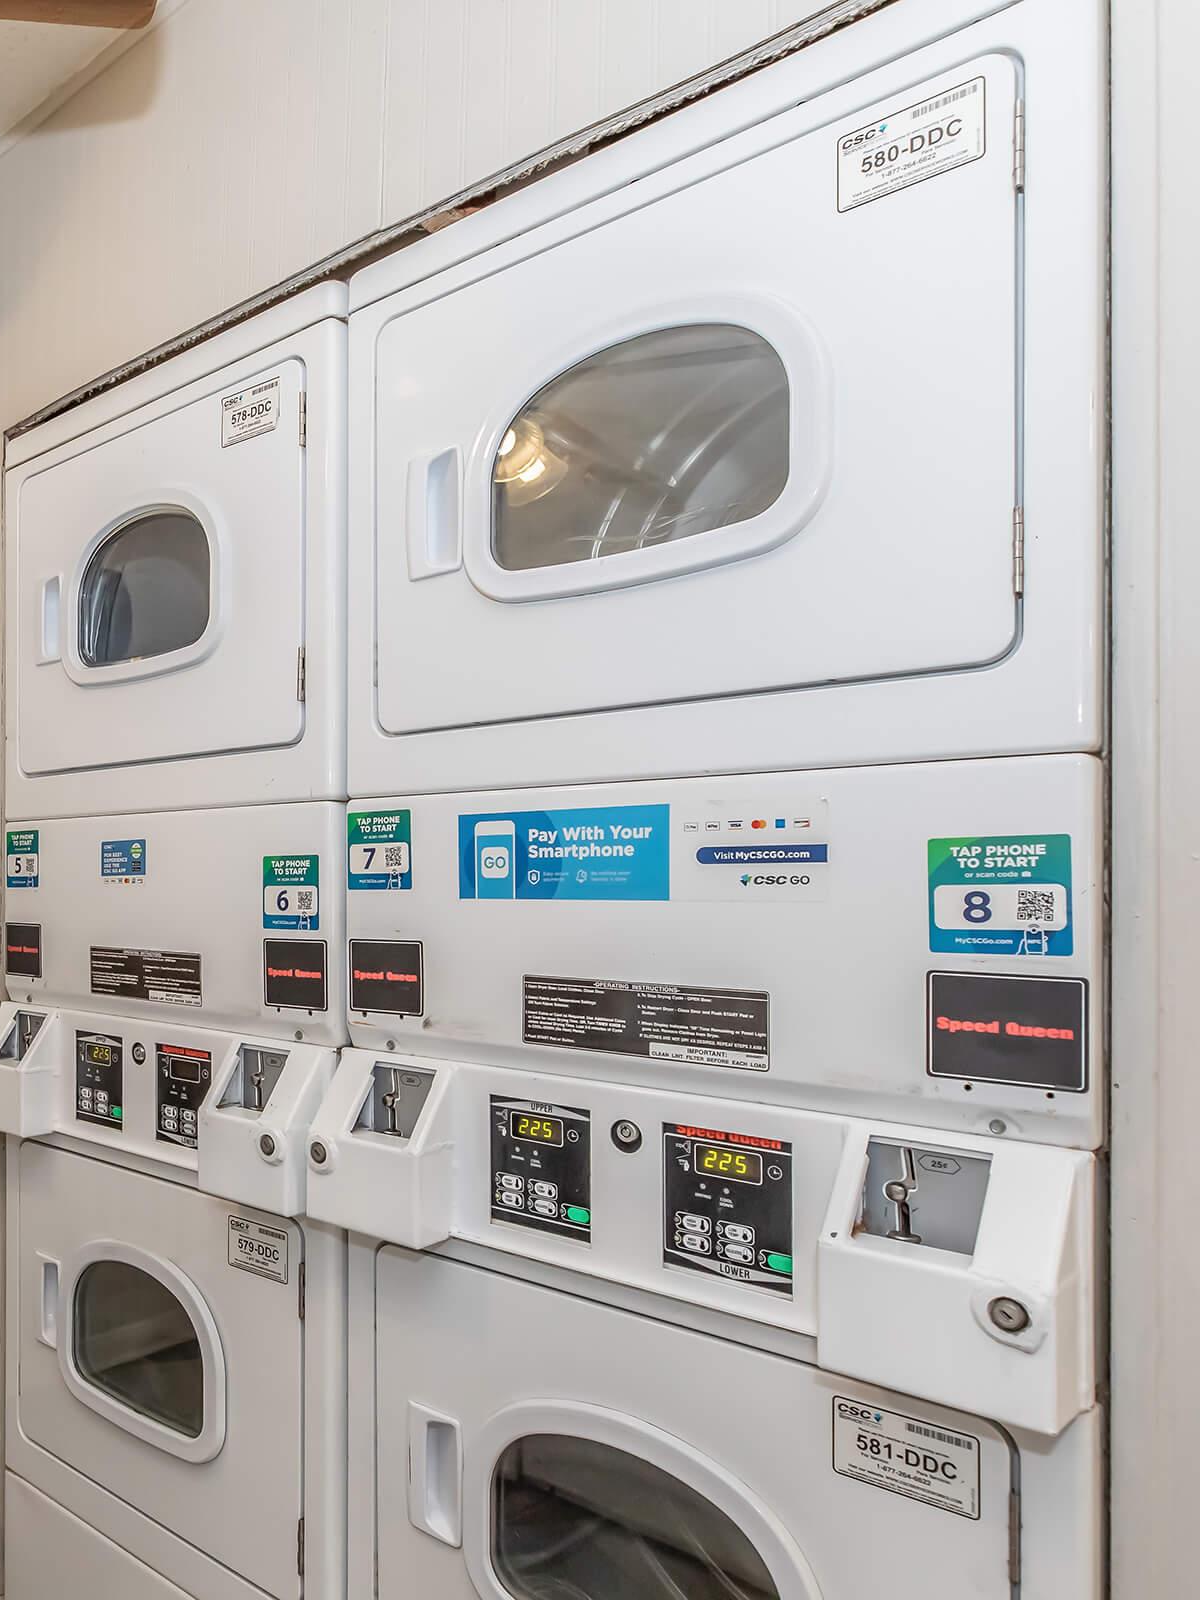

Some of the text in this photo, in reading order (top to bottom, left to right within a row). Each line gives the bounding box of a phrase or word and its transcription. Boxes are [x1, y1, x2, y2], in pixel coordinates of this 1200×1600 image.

[842, 129, 876, 150] CSC
[861, 118, 963, 173] 580-DDC
[224, 397, 238, 407] CSC
[231, 400, 272, 425] 578-DDC
[356, 816, 400, 826] TAP PHONE
[372, 824, 397, 832] START
[528, 825, 652, 844] Pay With Your
[528, 844, 634, 860] Smartphone
[714, 850, 810, 861] Visit MyCSCGO.com
[950, 844, 1047, 857] TAP PHONE
[15, 858, 22, 874] 5
[272, 860, 310, 868] TAP PHONE
[363, 848, 376, 870] 7
[484, 856, 506, 869] GO
[957, 856, 1039, 869] TO START
[274, 868, 284, 876] TO
[754, 875, 810, 886] CSC GO
[277, 890, 289, 912] 6
[963, 891, 992, 923] 8
[354, 970, 384, 981] Speed
[936, 1016, 1074, 1041] Speed Queen
[93, 1047, 110, 1061] 225
[687, 1048, 728, 1058] IMPORTANT:
[530, 1104, 553, 1113] UPPER
[519, 1118, 552, 1138] 225
[704, 1150, 747, 1174] 225
[930, 1160, 948, 1170] 25¢
[230, 1220, 245, 1229] CSC
[238, 1238, 280, 1261] 579-DDC
[719, 1263, 751, 1279] LOWER
[838, 1403, 872, 1420] CSC
[856, 1434, 958, 1480] 581-DDC
